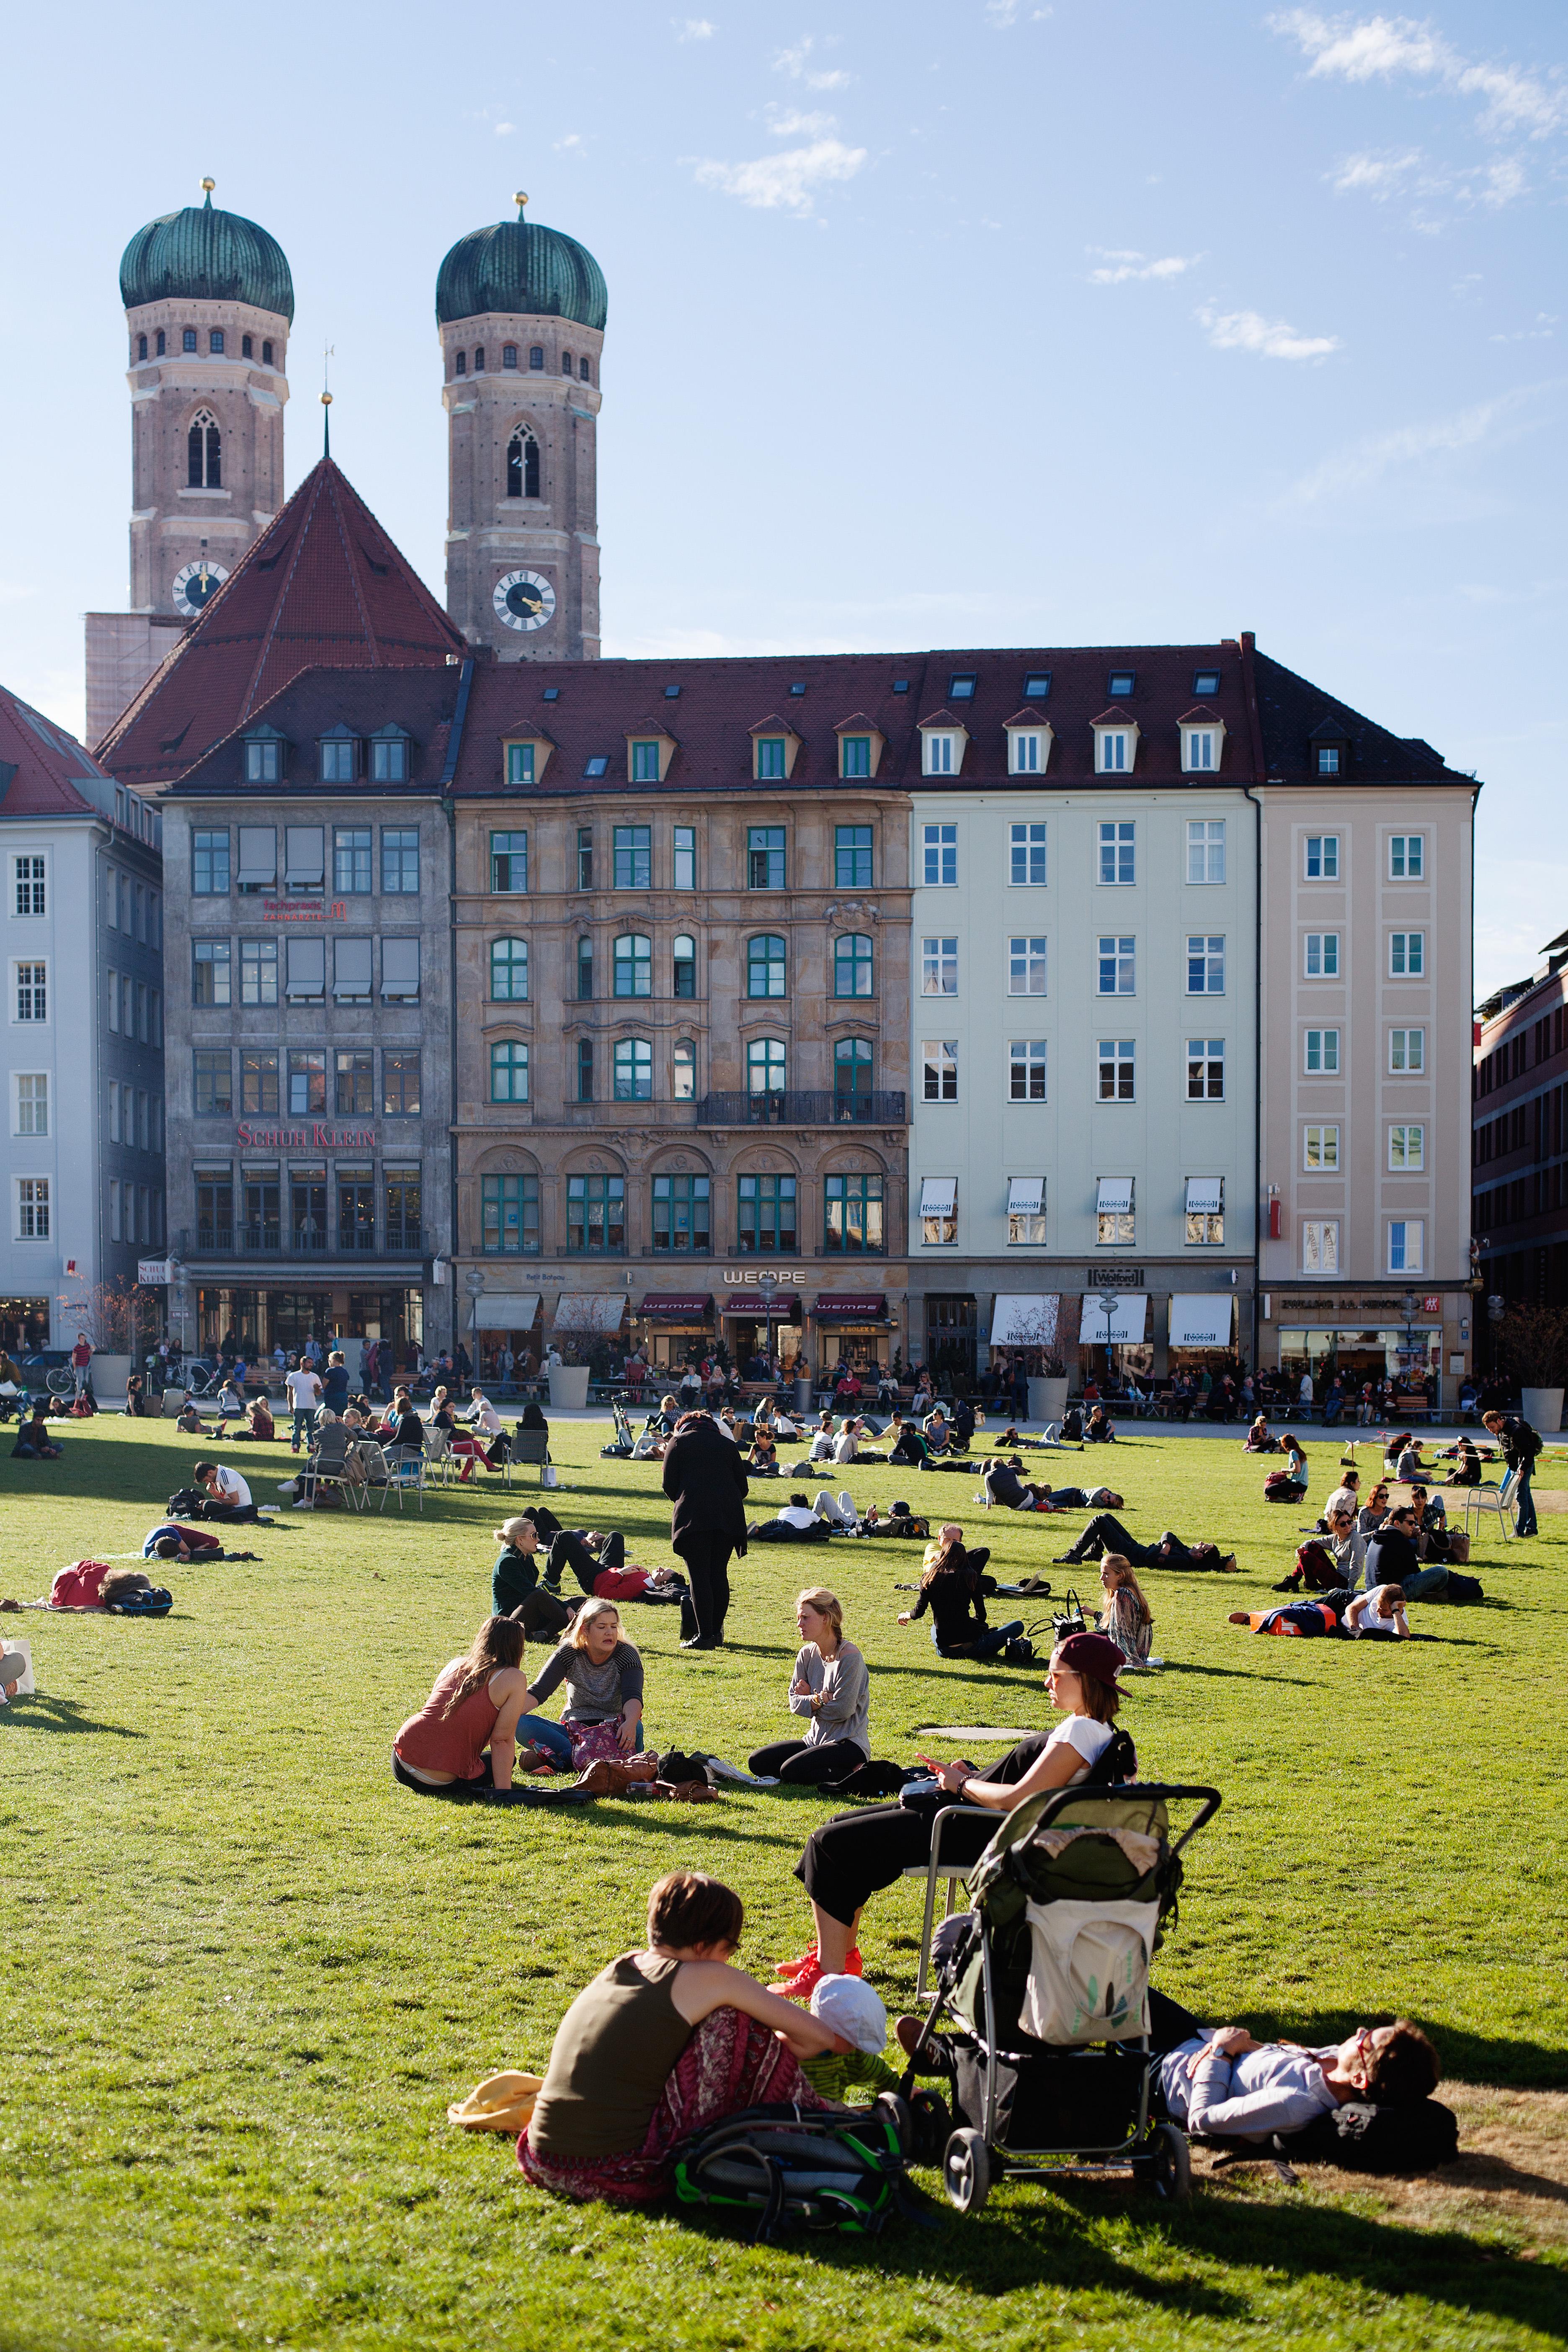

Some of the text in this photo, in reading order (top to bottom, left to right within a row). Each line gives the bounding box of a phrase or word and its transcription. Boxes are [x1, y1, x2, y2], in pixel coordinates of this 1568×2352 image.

[263, 900, 321, 911] fachpraxis
[238, 1123, 376, 1147] SCHUH KLEIN
[1307, 1225, 1318, 1259] KOSMETIK
[723, 1271, 805, 1284] WEMPE
[1097, 1273, 1135, 1282] Wolford
